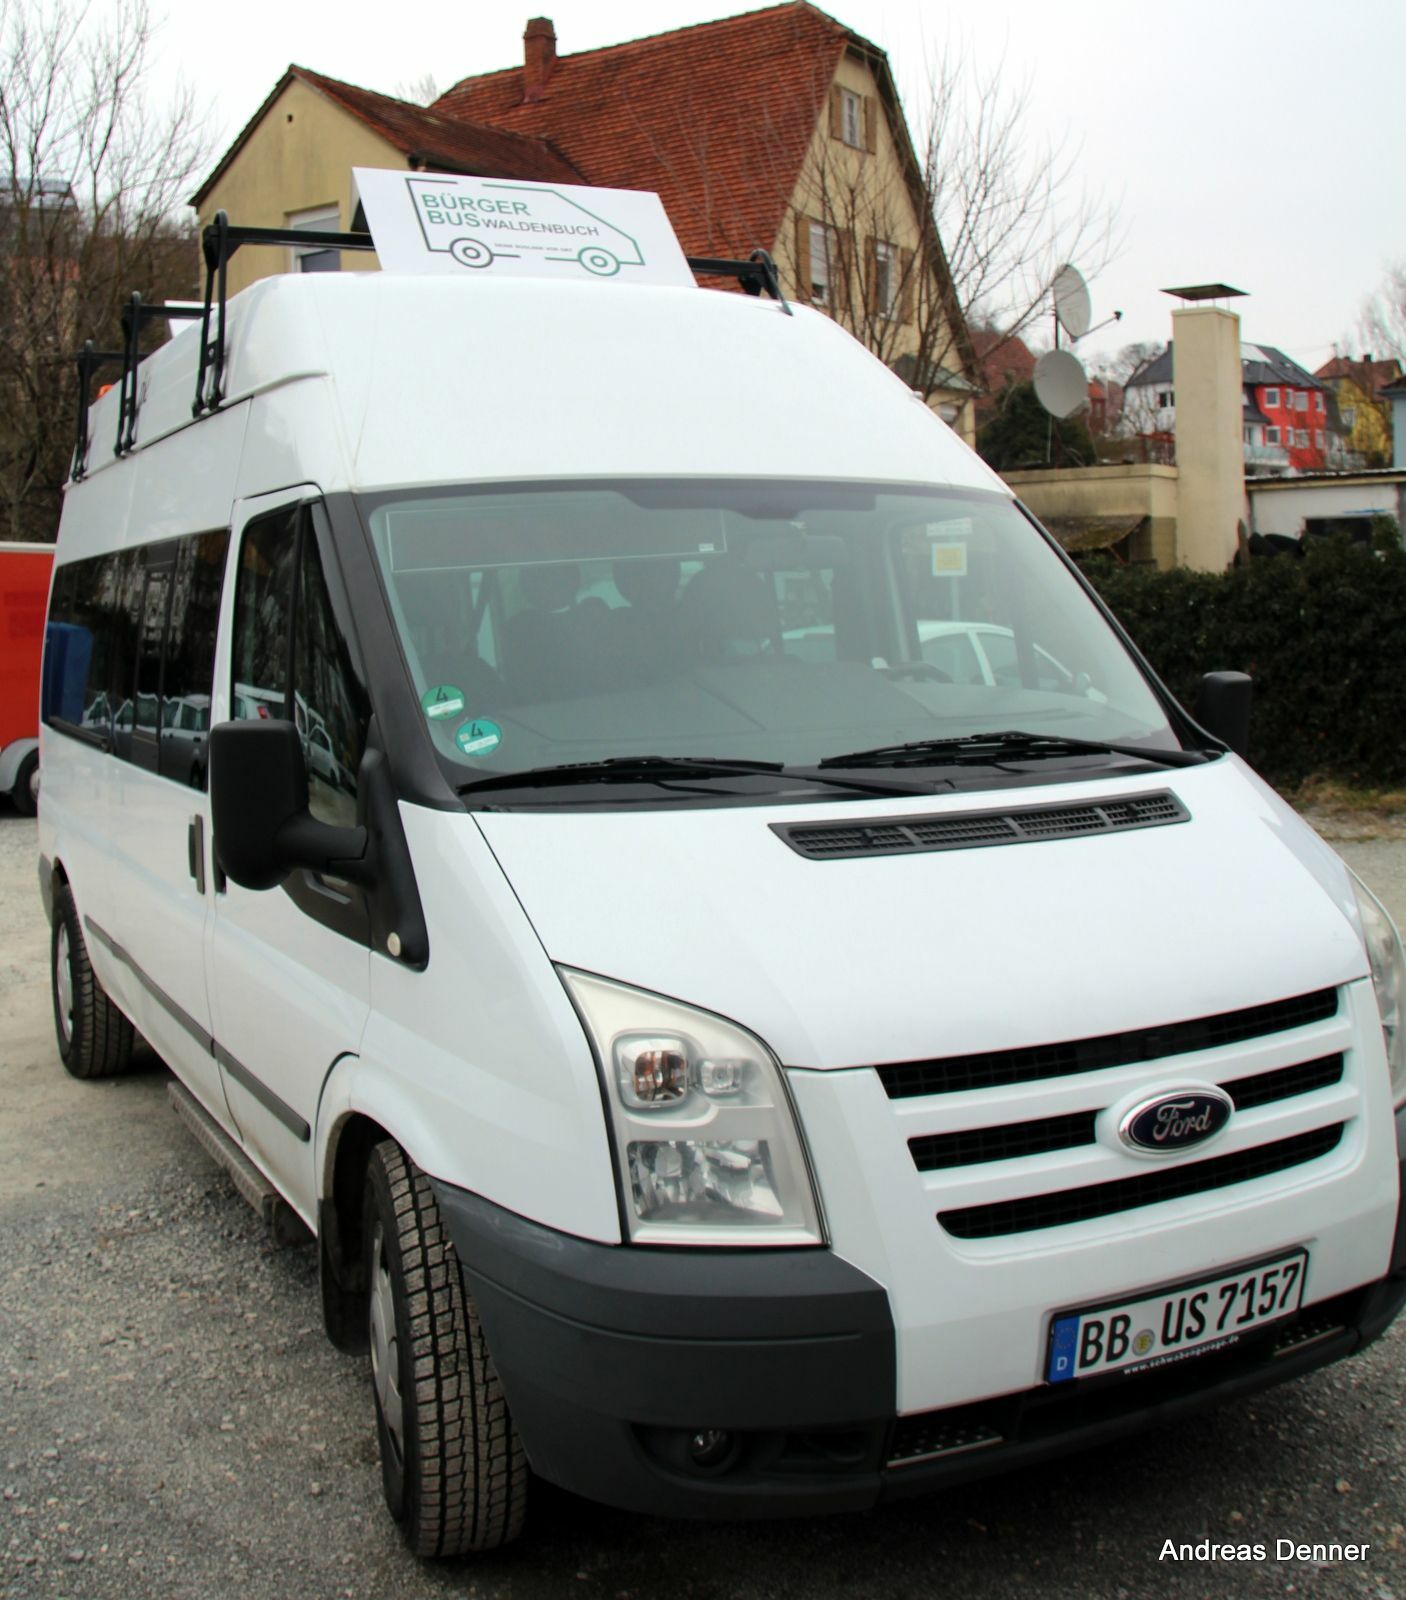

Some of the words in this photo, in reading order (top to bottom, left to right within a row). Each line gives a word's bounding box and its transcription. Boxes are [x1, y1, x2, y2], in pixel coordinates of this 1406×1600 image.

[421, 192, 531, 216] BÜRGER
[436, 687, 448, 701] 4
[471, 722, 484, 737] 4
[1153, 1100, 1211, 1142] Ford
[1056, 1355, 1068, 1371] D
[1078, 1313, 1132, 1370] BB
[1160, 1291, 1209, 1347] US
[1215, 1261, 1301, 1331] 7157
